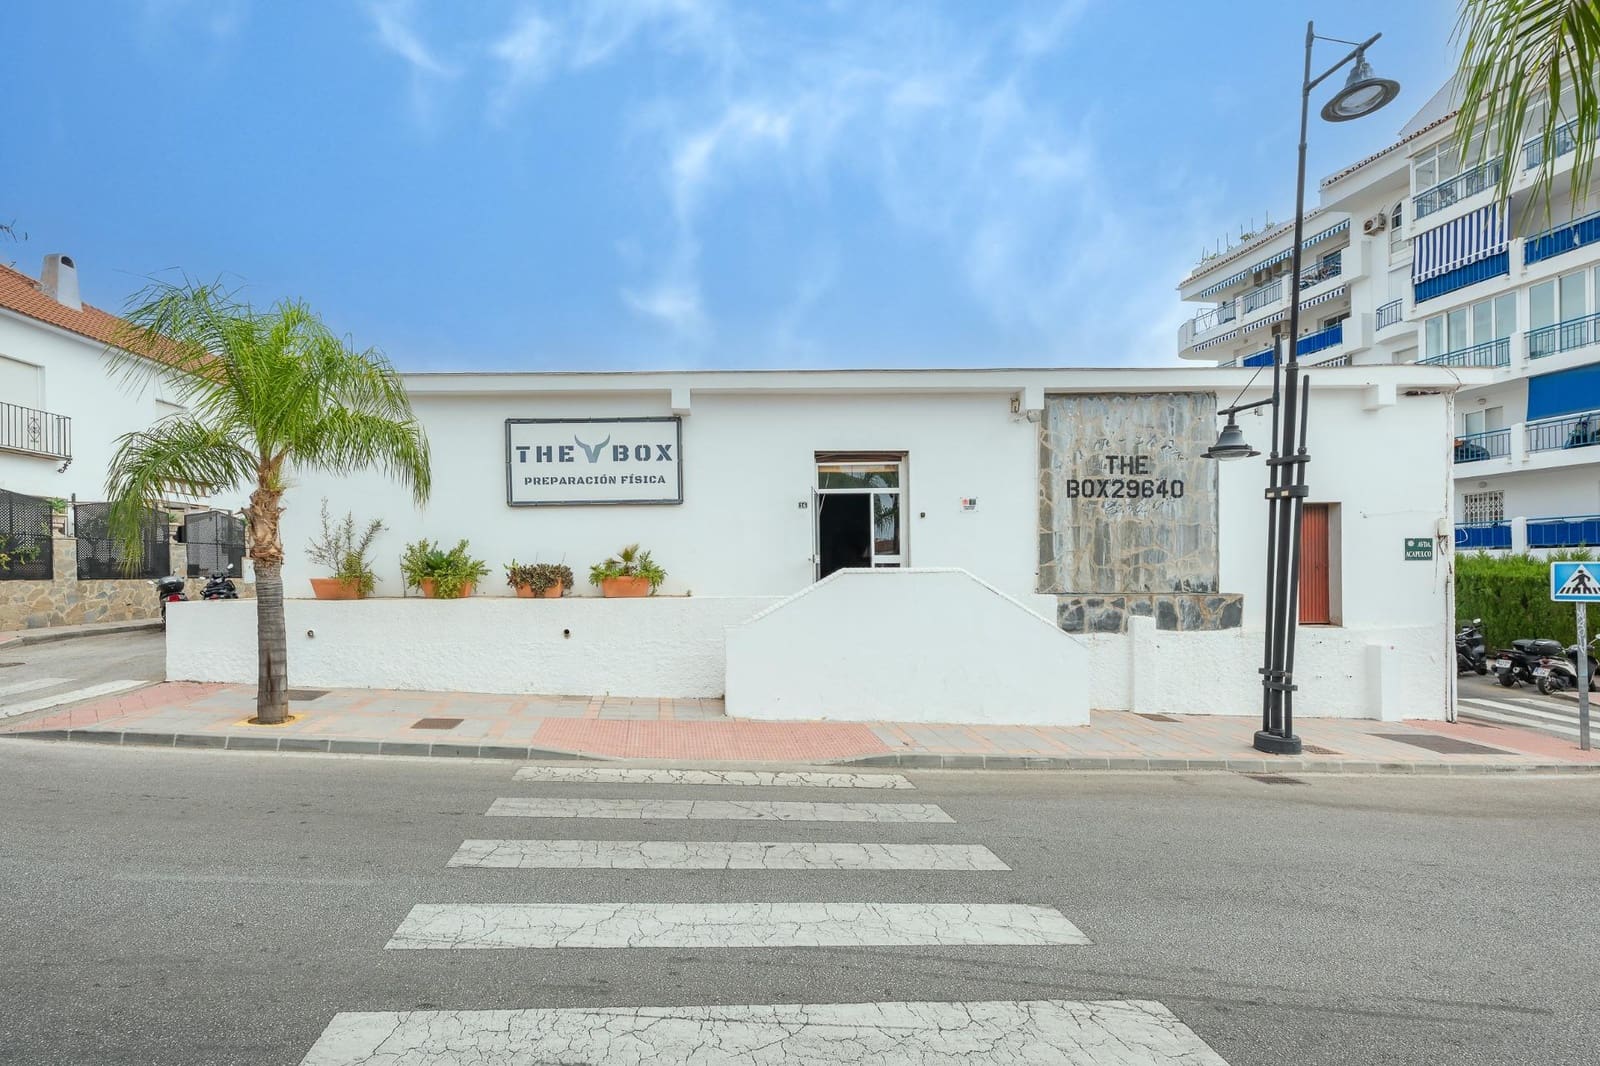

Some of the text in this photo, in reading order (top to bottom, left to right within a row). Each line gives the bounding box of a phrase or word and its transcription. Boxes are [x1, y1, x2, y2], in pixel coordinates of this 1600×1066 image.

[516, 444, 673, 463] THE BOX
[1105, 455, 1149, 475] THE
[525, 474, 666, 485] PREPARACIÓN FÍSICA
[1066, 479, 1184, 499] BOX29640
